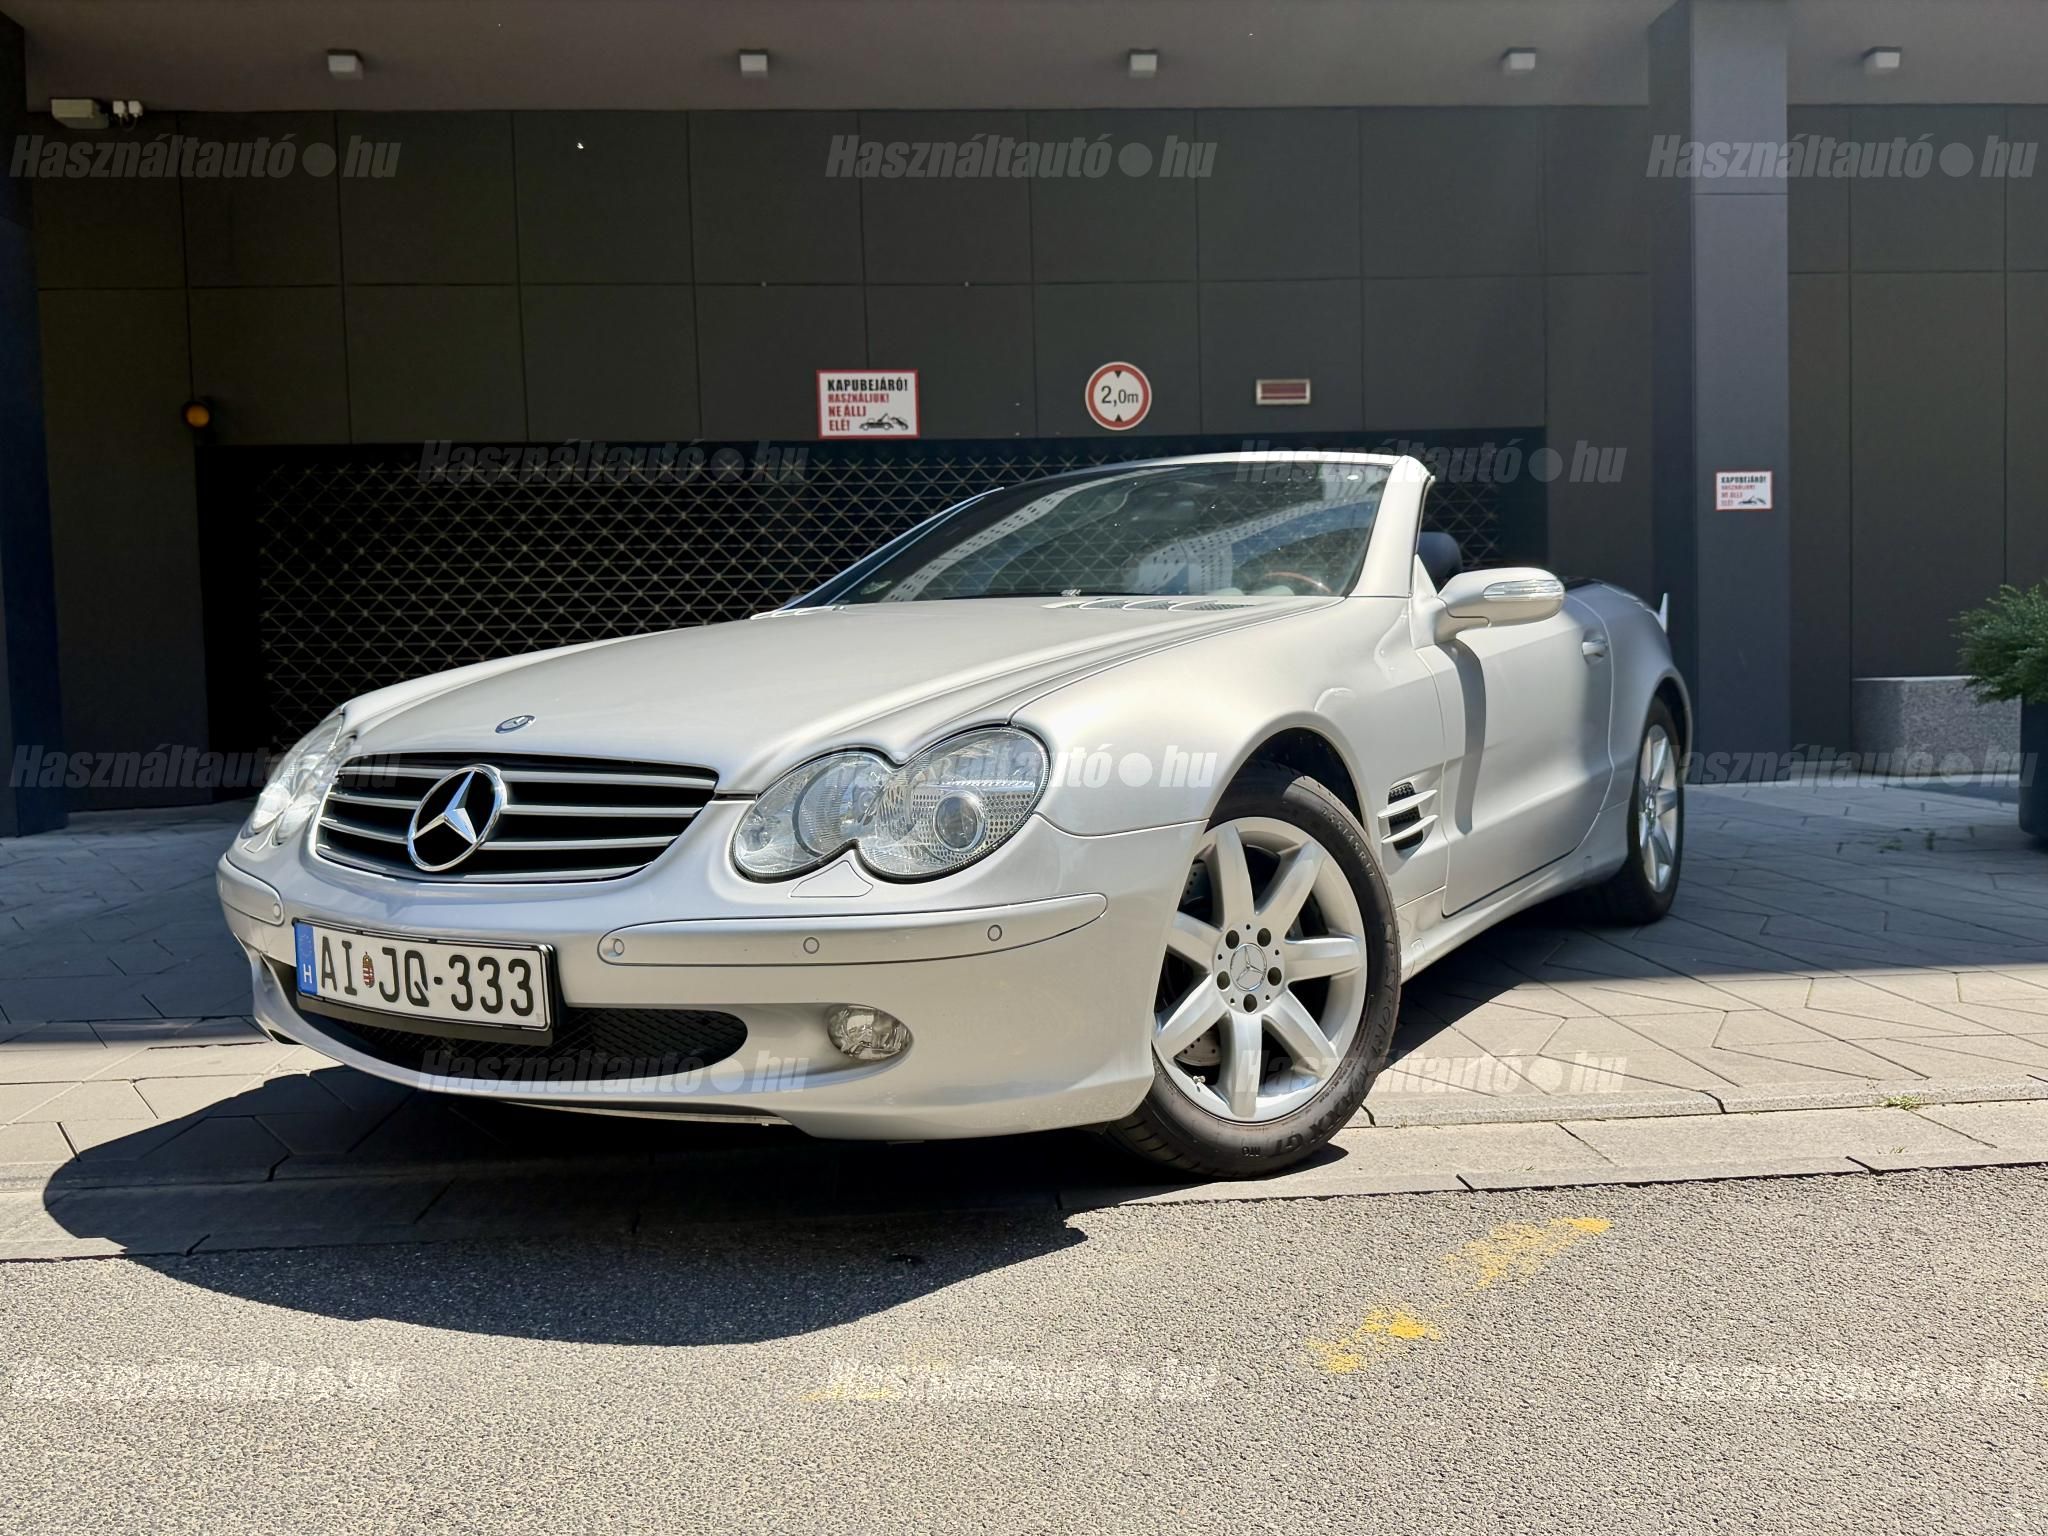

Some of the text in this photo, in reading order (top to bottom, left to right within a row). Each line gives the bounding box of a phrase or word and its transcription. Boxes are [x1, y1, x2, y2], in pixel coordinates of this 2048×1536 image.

[827, 376, 908, 392] KAPUBEJÁRÓ!
[827, 393, 889, 403] HASZNÁLJUK!
[828, 406, 842, 417] NE
[303, 963, 314, 985] H
